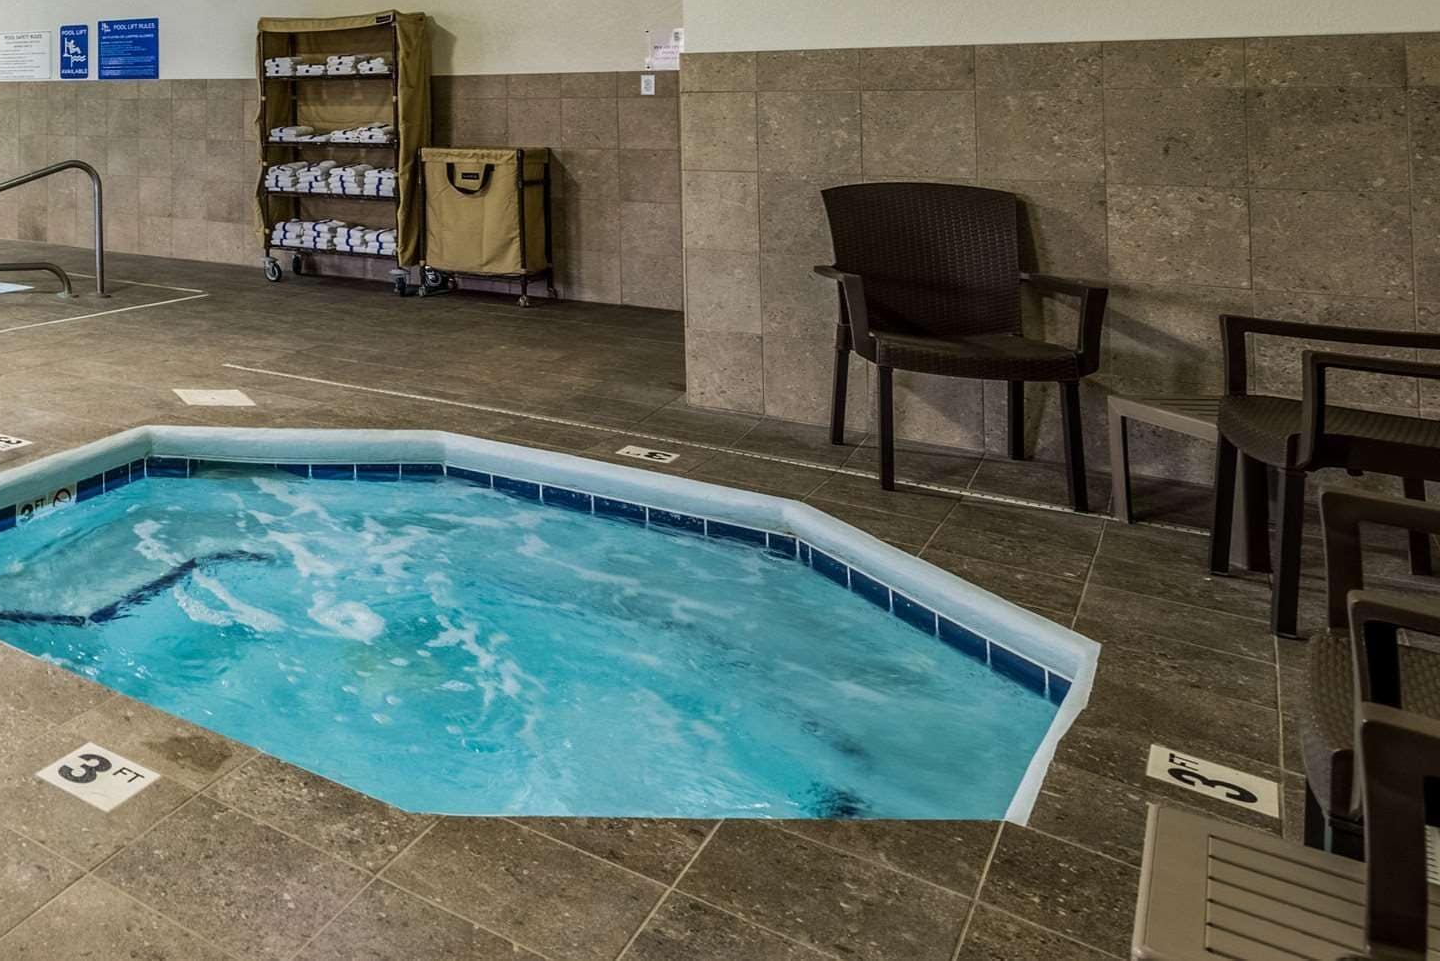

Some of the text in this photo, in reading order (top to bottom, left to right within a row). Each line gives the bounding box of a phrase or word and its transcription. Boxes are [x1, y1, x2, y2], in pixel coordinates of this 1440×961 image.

[58, 753, 145, 783] 3 FT
[1167, 752, 1258, 803] 3 FT
